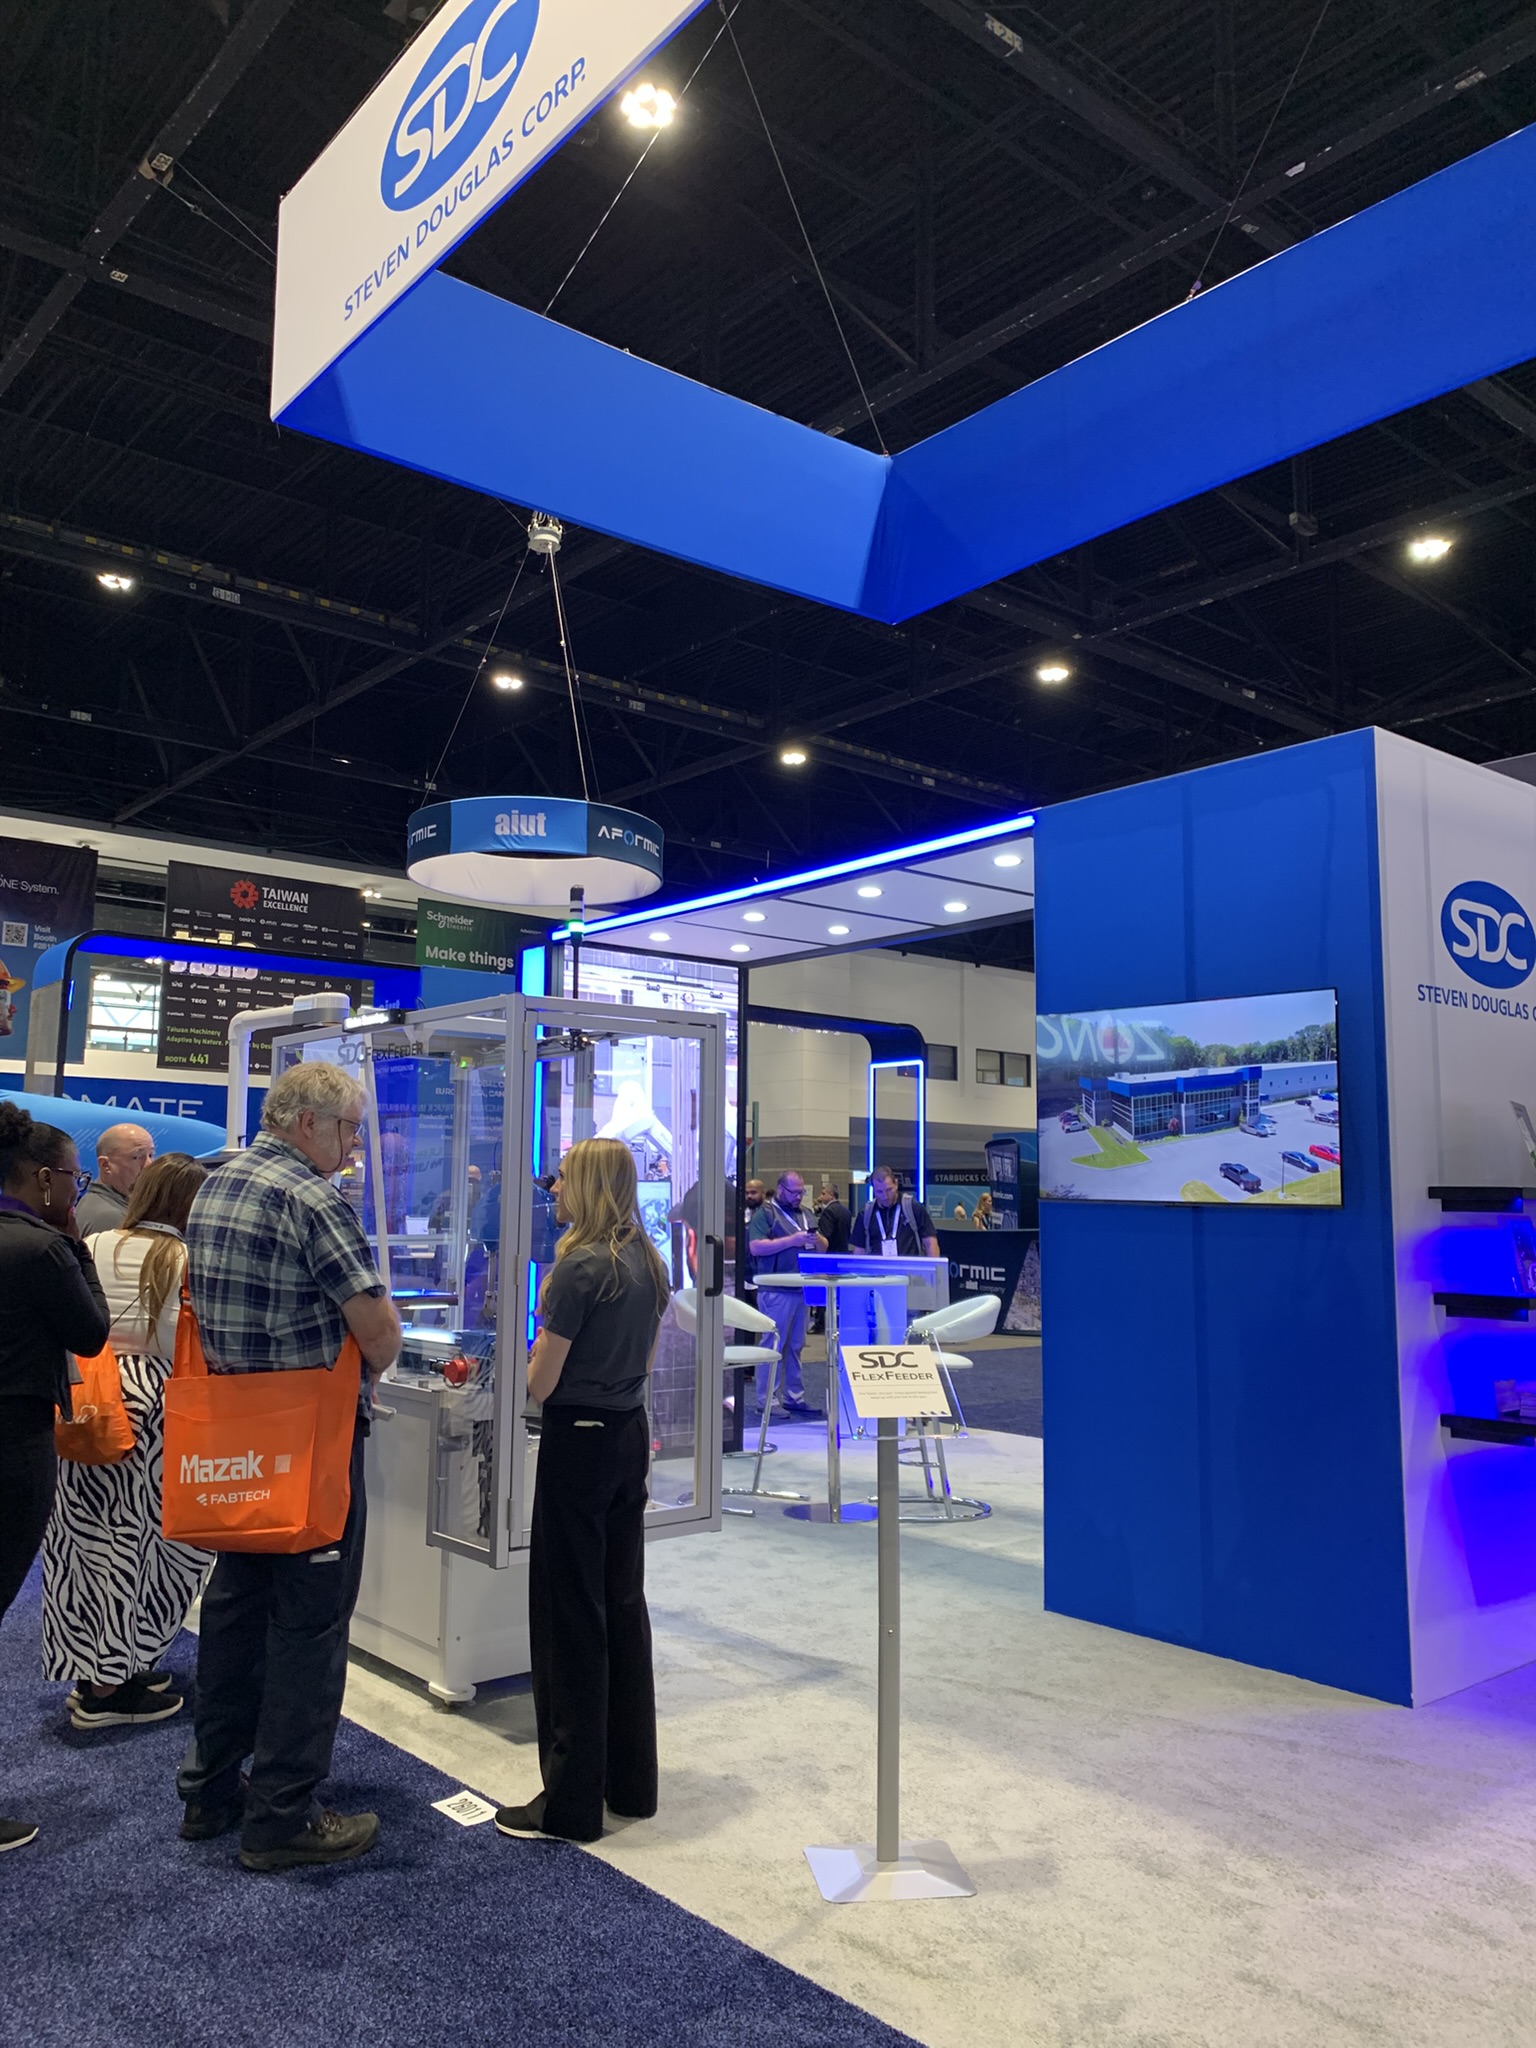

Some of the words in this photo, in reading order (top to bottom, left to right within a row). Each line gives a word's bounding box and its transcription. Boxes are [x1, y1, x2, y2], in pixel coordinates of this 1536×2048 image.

[394, 0, 518, 199] SDC
[344, 236, 410, 321] STEVEN
[416, 129, 513, 249] DOUGLAS
[521, 56, 586, 137] CORP.
[495, 810, 546, 836] aiut
[20, 881, 60, 894] System.
[262, 886, 309, 904] TAIWAN
[263, 900, 308, 914] EXCELLENCE
[426, 910, 474, 926] Schneider
[34, 924, 51, 933] Visit
[1451, 898, 1528, 970] SDC
[34, 933, 57, 942] Booth
[426, 946, 466, 962] Make
[469, 952, 514, 971] things
[1417, 984, 1468, 1008] STEVEN
[1472, 994, 1529, 1020] DOUGLAS
[166, 1026, 188, 1034] Taiwan
[190, 1028, 221, 1037] Machinery
[166, 1036, 192, 1044] Adaptive
[252, 1042, 260, 1050] by
[190, 1053, 208, 1064] 441
[934, 1174, 979, 1182] STARBUCKS
[966, 1280, 978, 1290] aiut
[980, 1285, 1006, 1294] company
[858, 1352, 918, 1368] SDC
[852, 1372, 934, 1382] FLEXFEEDER
[180, 1450, 264, 1484] Mazak
[210, 1489, 270, 1505] FABTECH
